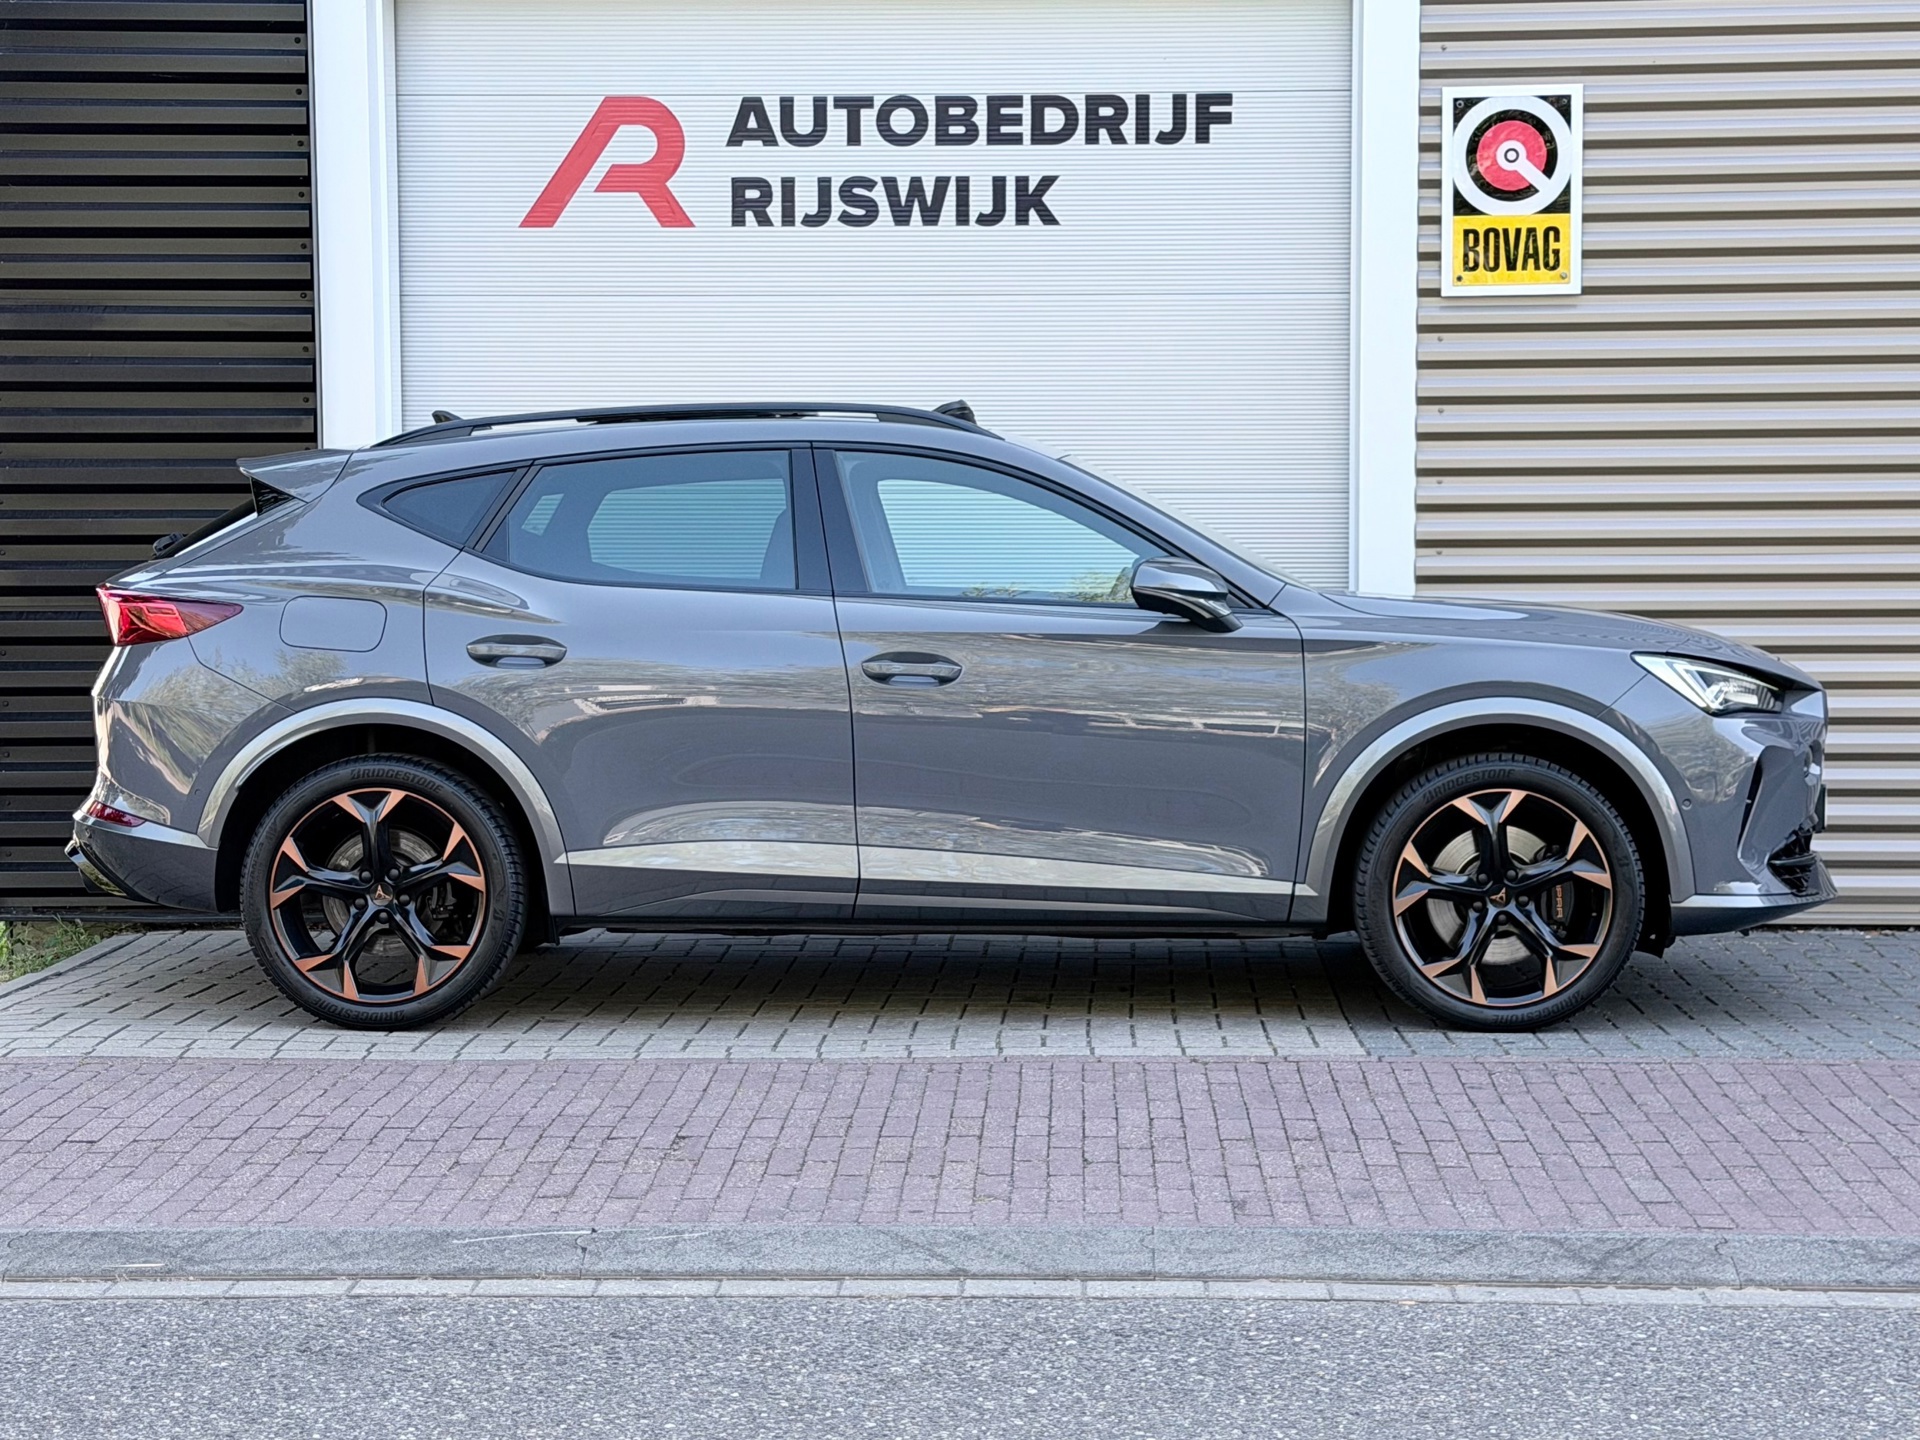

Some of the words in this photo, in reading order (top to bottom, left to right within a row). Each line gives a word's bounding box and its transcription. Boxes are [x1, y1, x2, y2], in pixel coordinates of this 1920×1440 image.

[726, 93, 1233, 148] AUTOBEDRIJF
[731, 176, 1060, 228] RIJSWIJK
[1463, 226, 1560, 273] BOVAG
[349, 768, 442, 793] BRIDGESTONE
[1422, 768, 1515, 804] BRIDGESTONE
